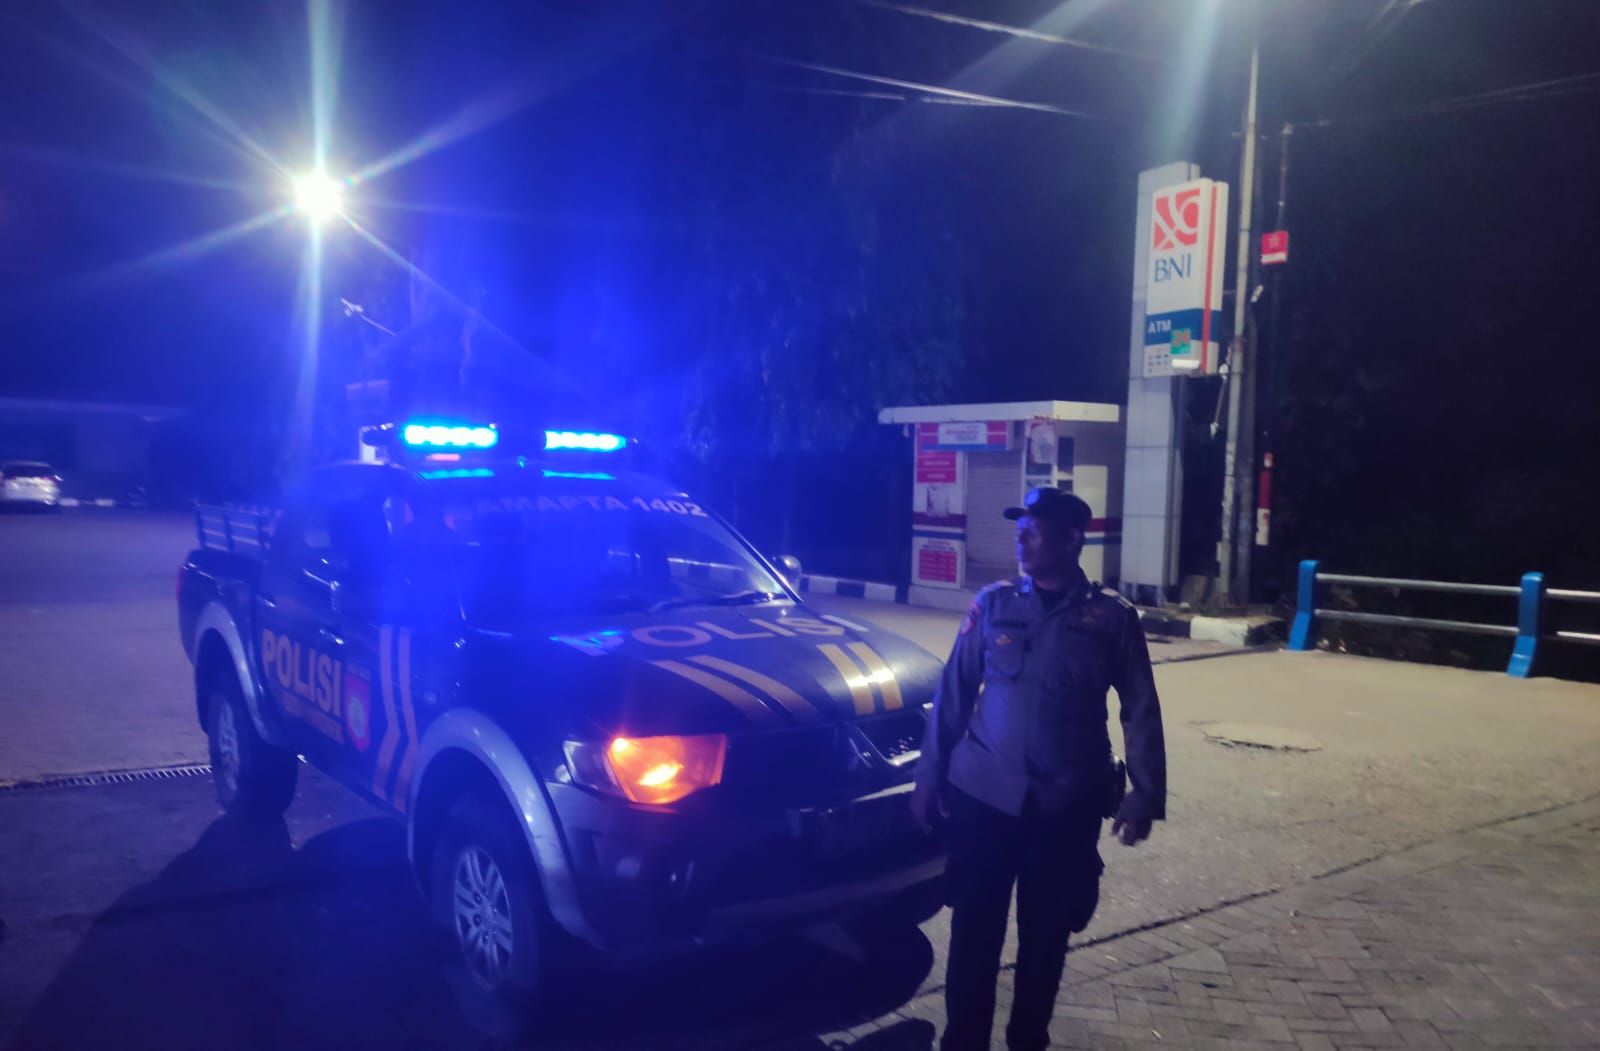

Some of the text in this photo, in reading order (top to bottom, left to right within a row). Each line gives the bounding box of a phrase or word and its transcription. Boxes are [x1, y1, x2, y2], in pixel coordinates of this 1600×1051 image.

[1153, 254, 1191, 283] BNI
[1148, 320, 1172, 334] ATM
[453, 495, 708, 519] AMAPTA 1402
[551, 615, 869, 656] POLISI
[262, 628, 342, 717] POLISI
